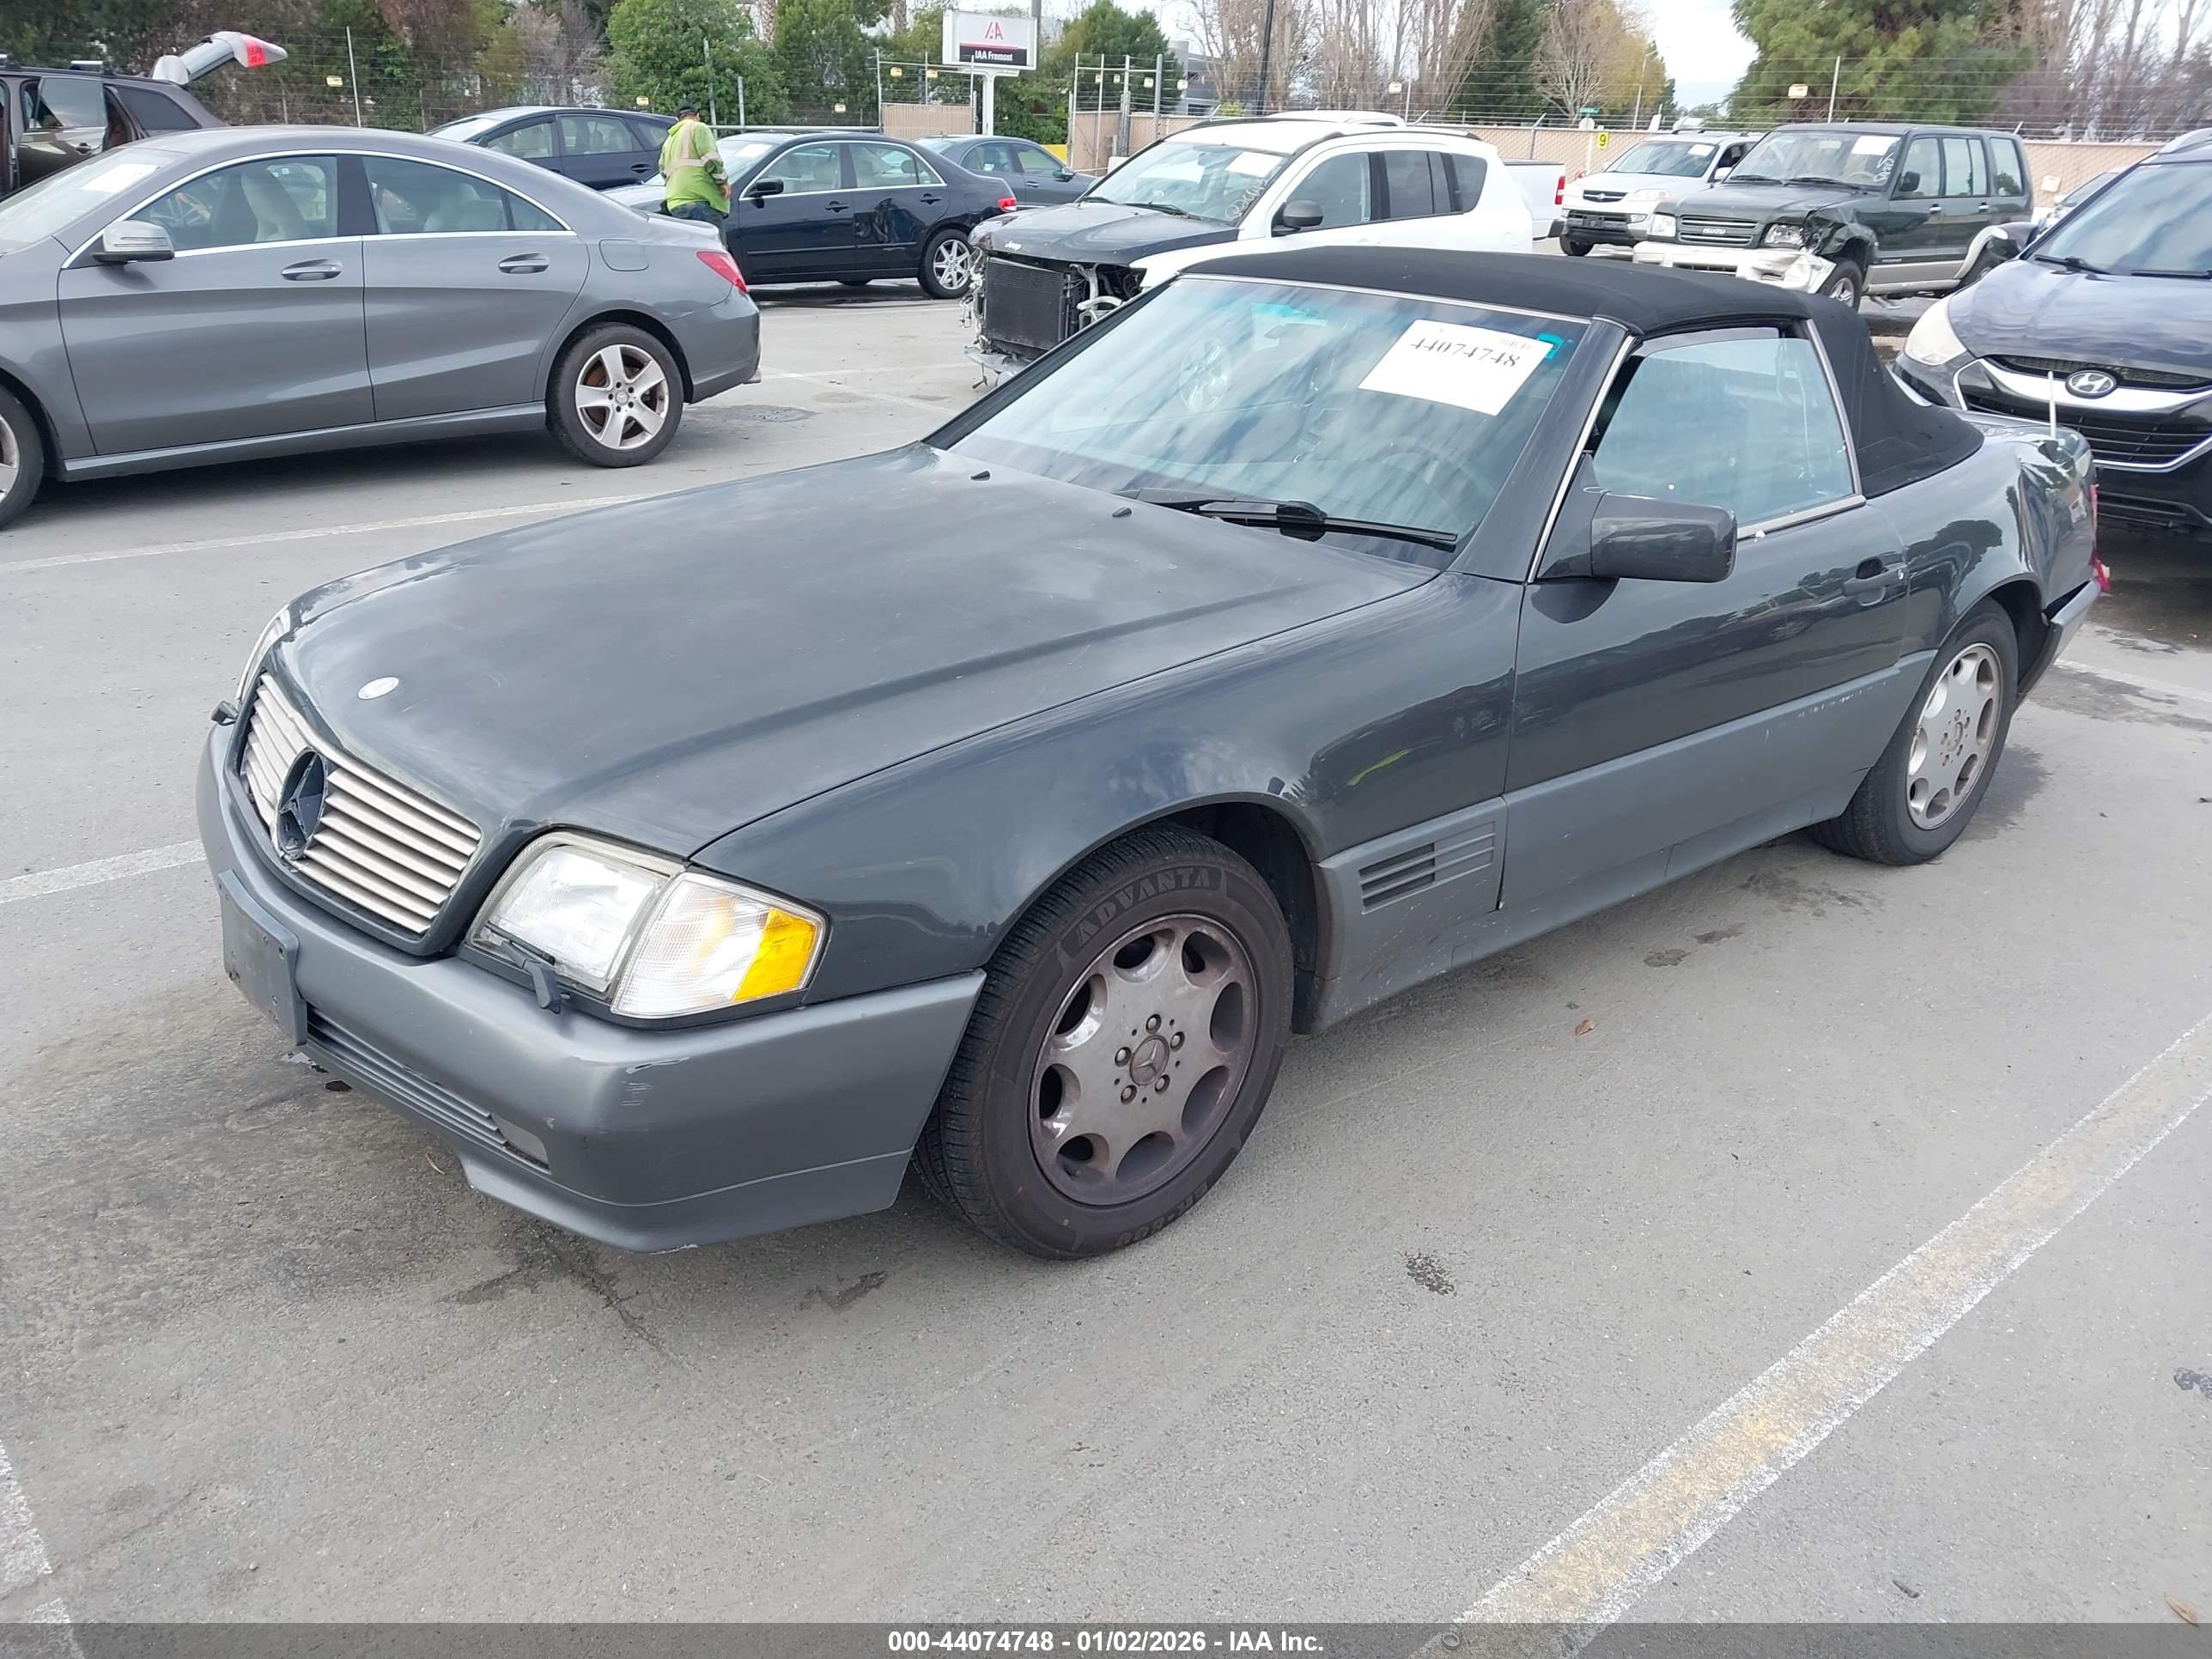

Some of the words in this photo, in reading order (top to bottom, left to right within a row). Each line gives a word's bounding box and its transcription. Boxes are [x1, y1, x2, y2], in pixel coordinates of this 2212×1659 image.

[975, 50, 988, 60] IAA
[988, 52, 1013, 62] Fremont
[1599, 134, 1607, 147] 9
[1411, 337, 1521, 368] 44074748
[1077, 866, 1210, 947] ADVANTA
